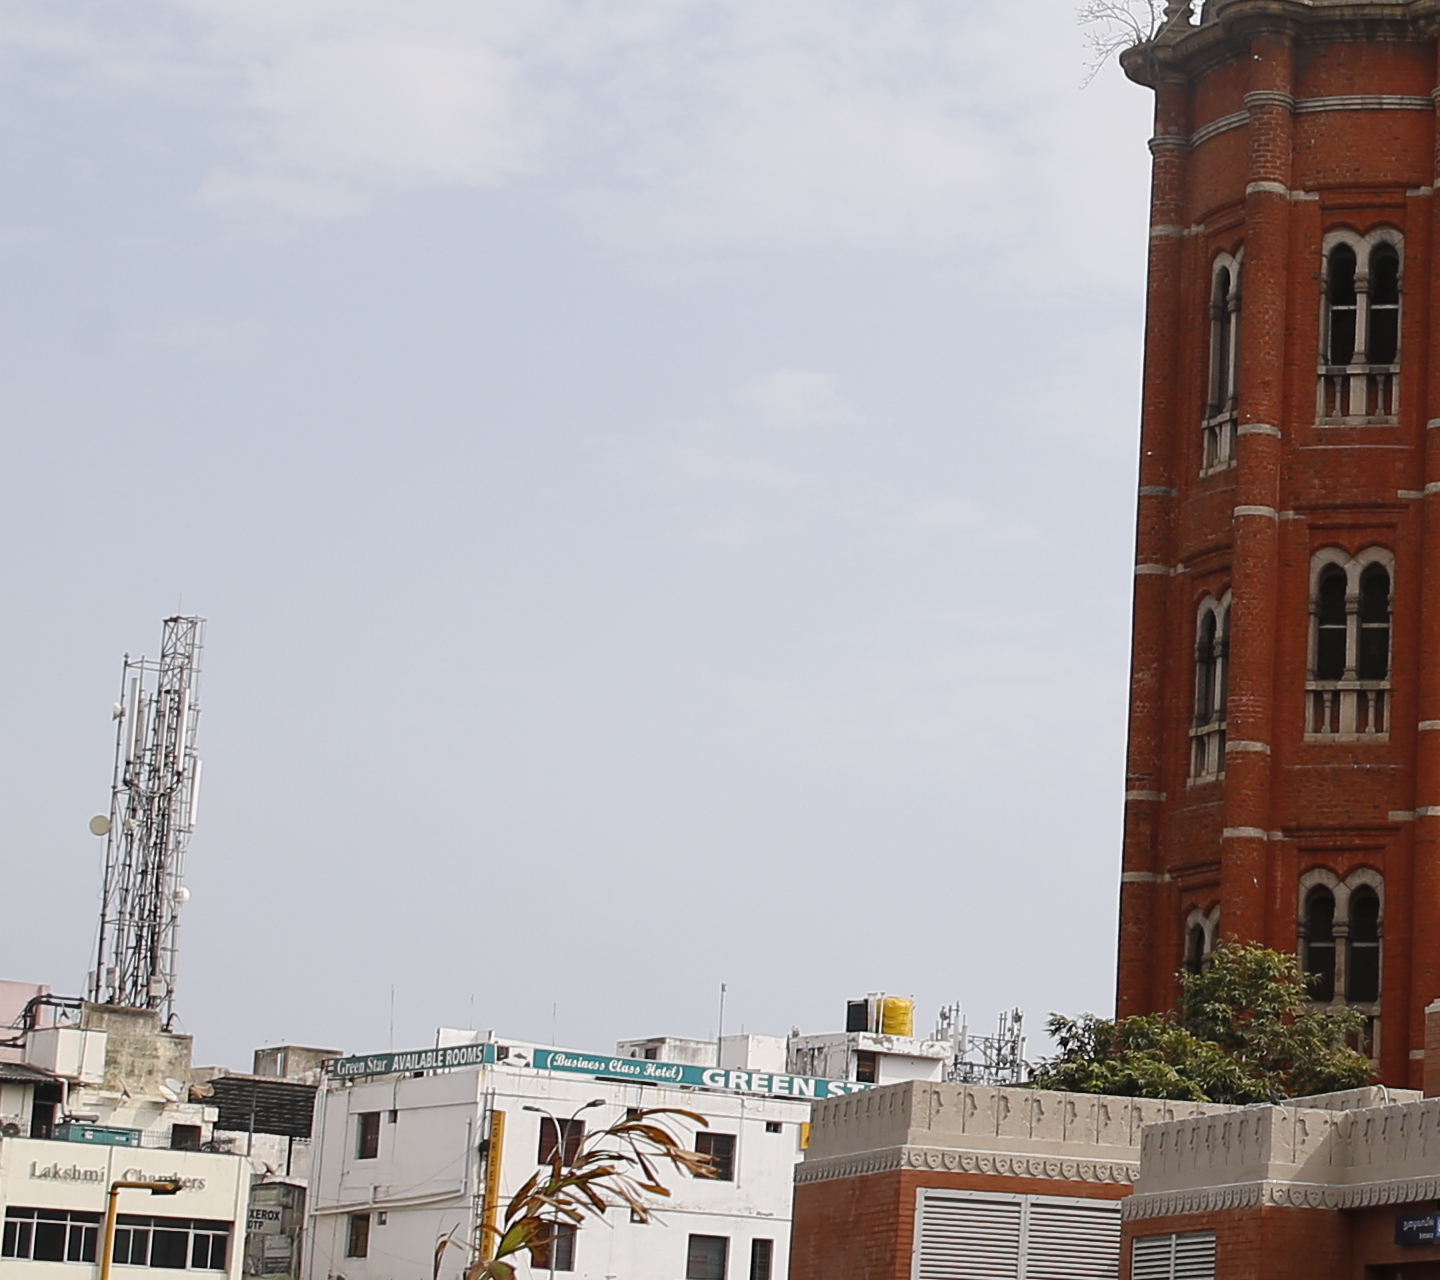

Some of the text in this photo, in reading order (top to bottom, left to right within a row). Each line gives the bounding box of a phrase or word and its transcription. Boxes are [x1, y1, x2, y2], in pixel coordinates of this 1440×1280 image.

[337, 1046, 483, 1076] Green Star AVAILABLE ROOMS
[608, 1060, 642, 1076] Class
[702, 1069, 815, 1097] GREEN
[29, 1160, 105, 1183] Lakshmi
[249, 1208, 281, 1220] XEROX
